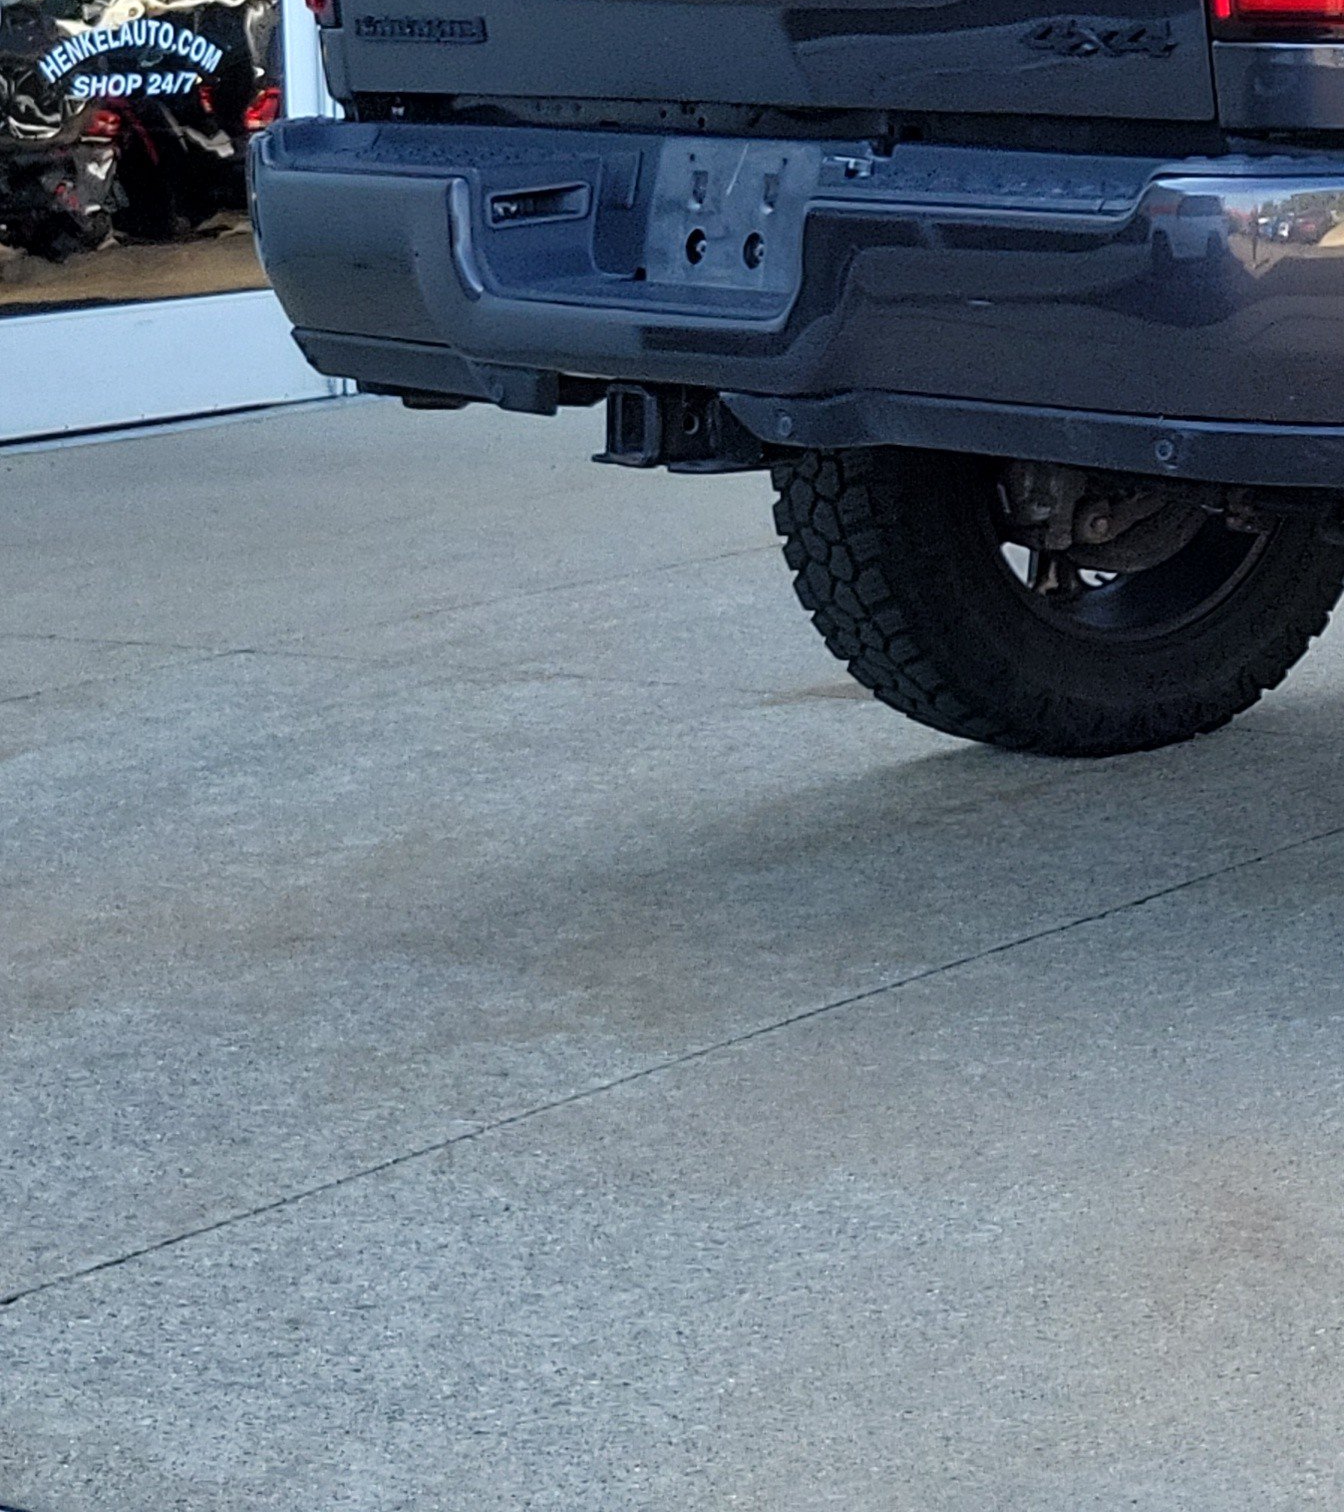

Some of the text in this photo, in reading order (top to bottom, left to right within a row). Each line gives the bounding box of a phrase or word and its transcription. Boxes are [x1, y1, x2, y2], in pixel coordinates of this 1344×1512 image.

[37, 18, 223, 84] HENKELAUTO.COM
[72, 72, 197, 98] SHOP 24/7
